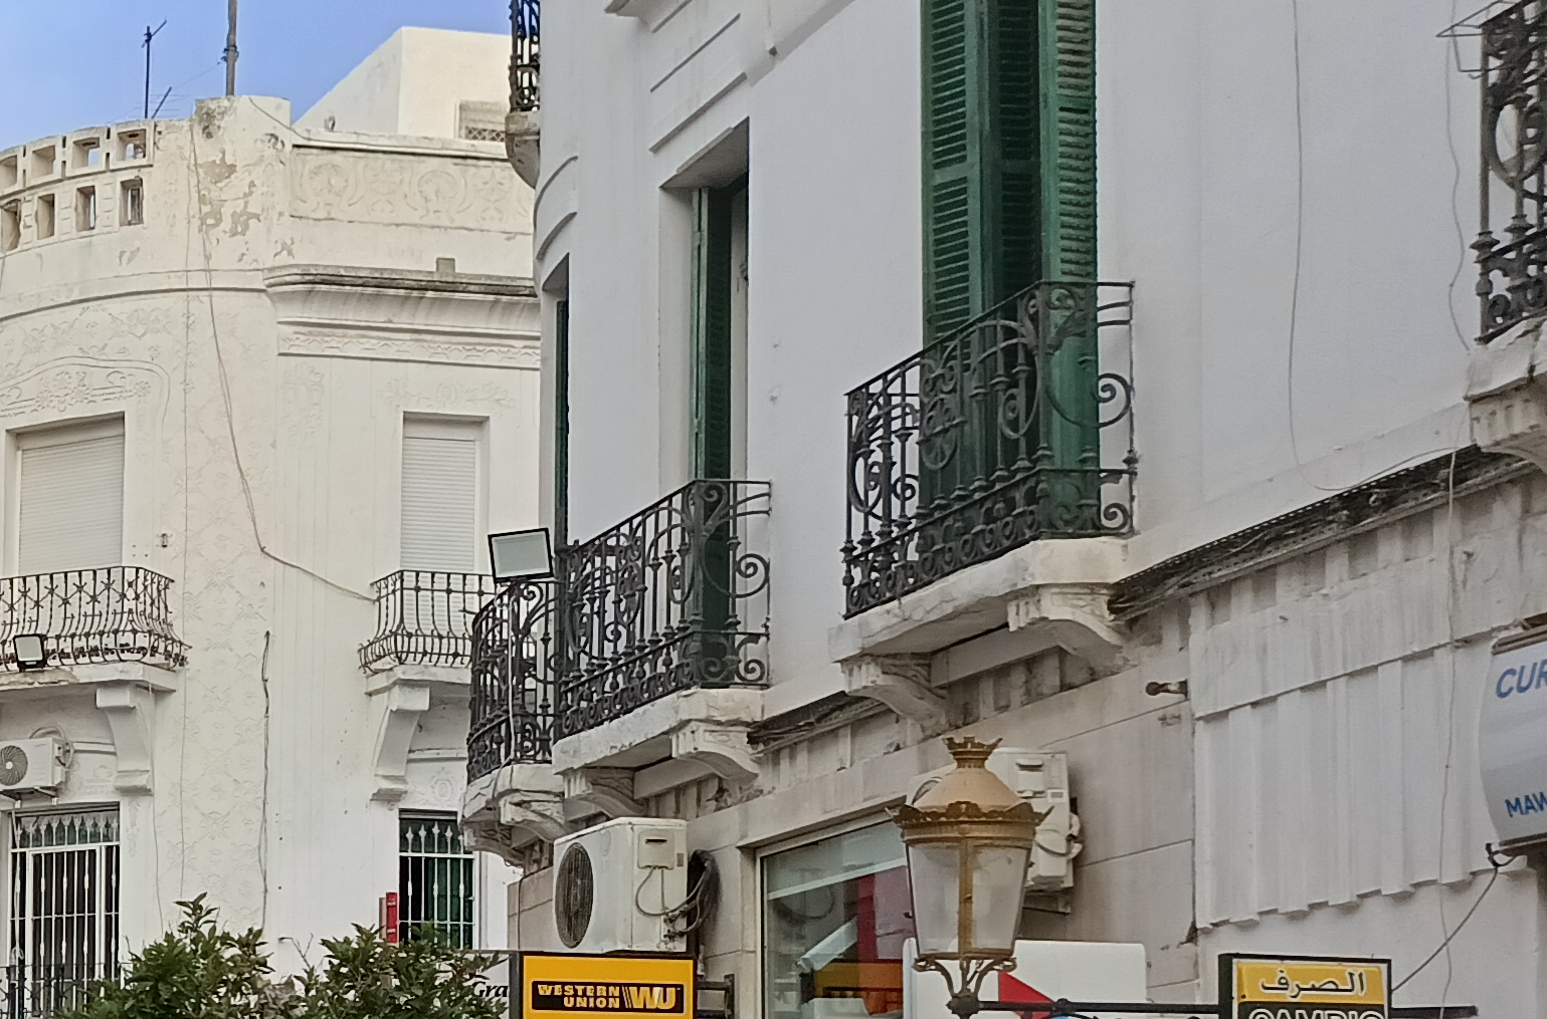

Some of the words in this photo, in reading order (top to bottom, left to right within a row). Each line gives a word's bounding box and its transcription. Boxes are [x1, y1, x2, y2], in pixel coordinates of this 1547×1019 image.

[1261, 968, 1366, 999] الصرف
[537, 984, 620, 997] WESTERN
[628, 986, 677, 1010] WU
[563, 997, 620, 1008] UNION
